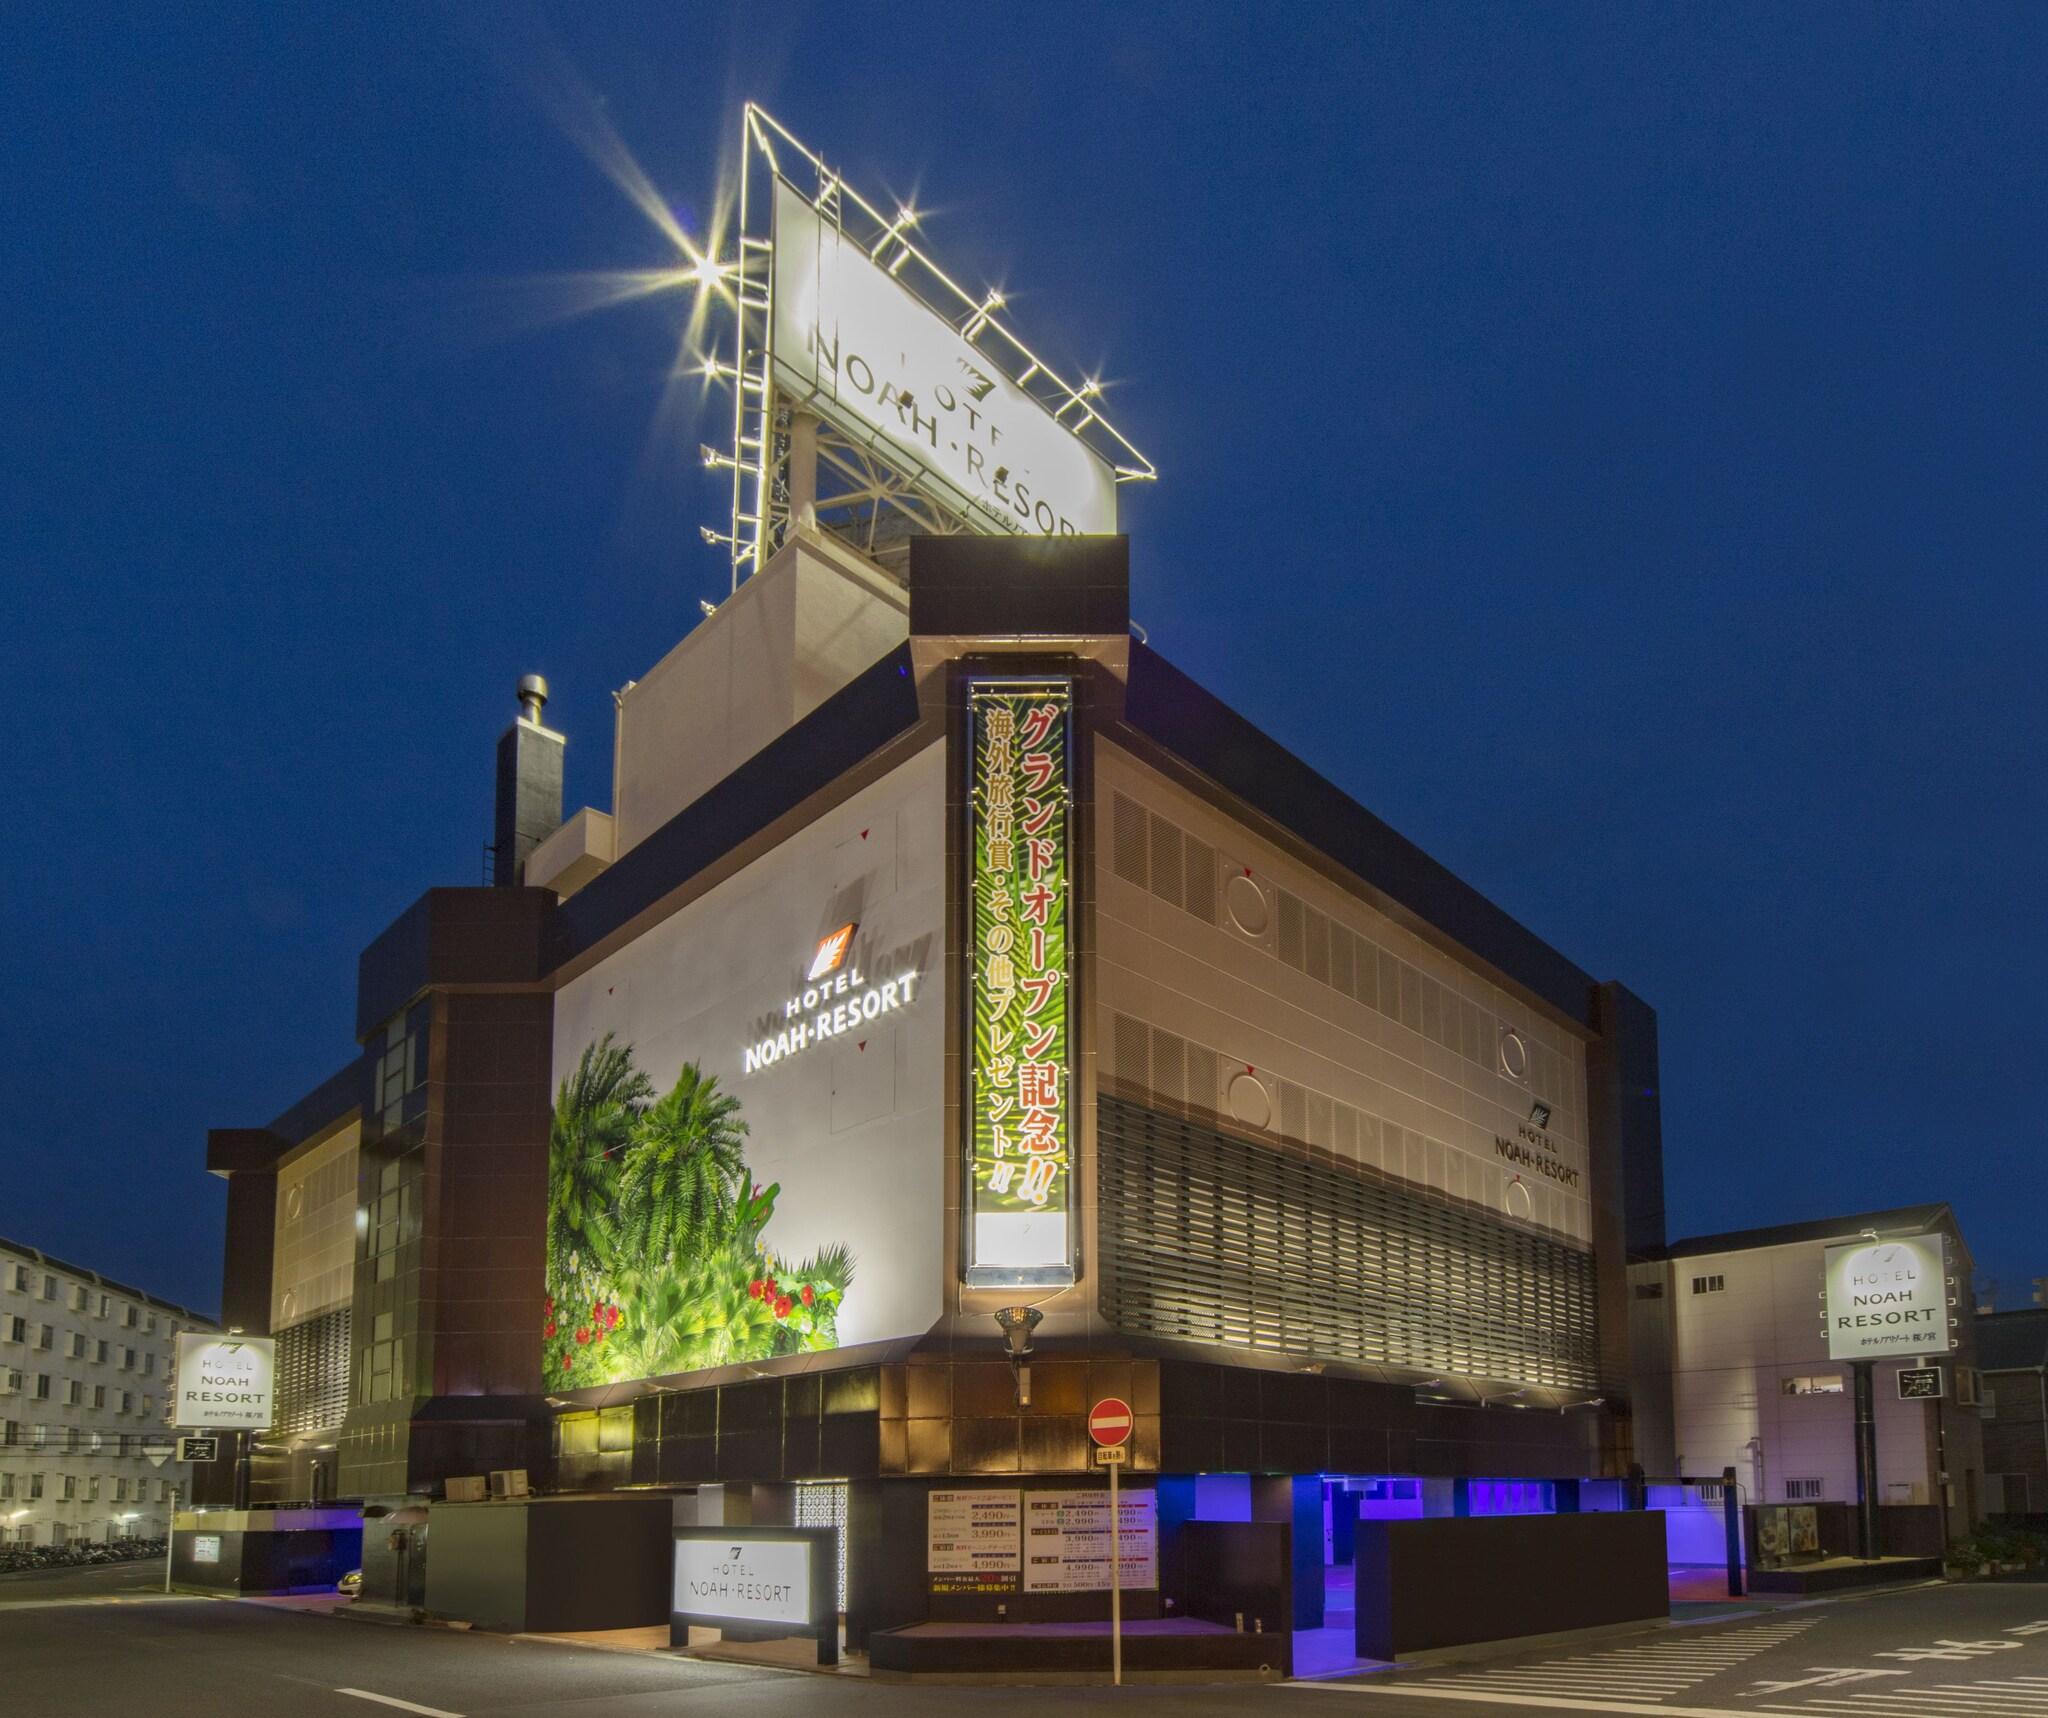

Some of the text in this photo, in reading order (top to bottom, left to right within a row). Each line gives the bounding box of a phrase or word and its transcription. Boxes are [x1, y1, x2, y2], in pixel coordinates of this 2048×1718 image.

[786, 967, 864, 1018] HOTEL
[1518, 1126, 1557, 1153] HOTEL
[1853, 1290, 1912, 1307] NOAH
[1838, 1308, 1936, 1328] RESORT
[201, 1376, 249, 1386] NOAH
[186, 1391, 264, 1404] RESORT
